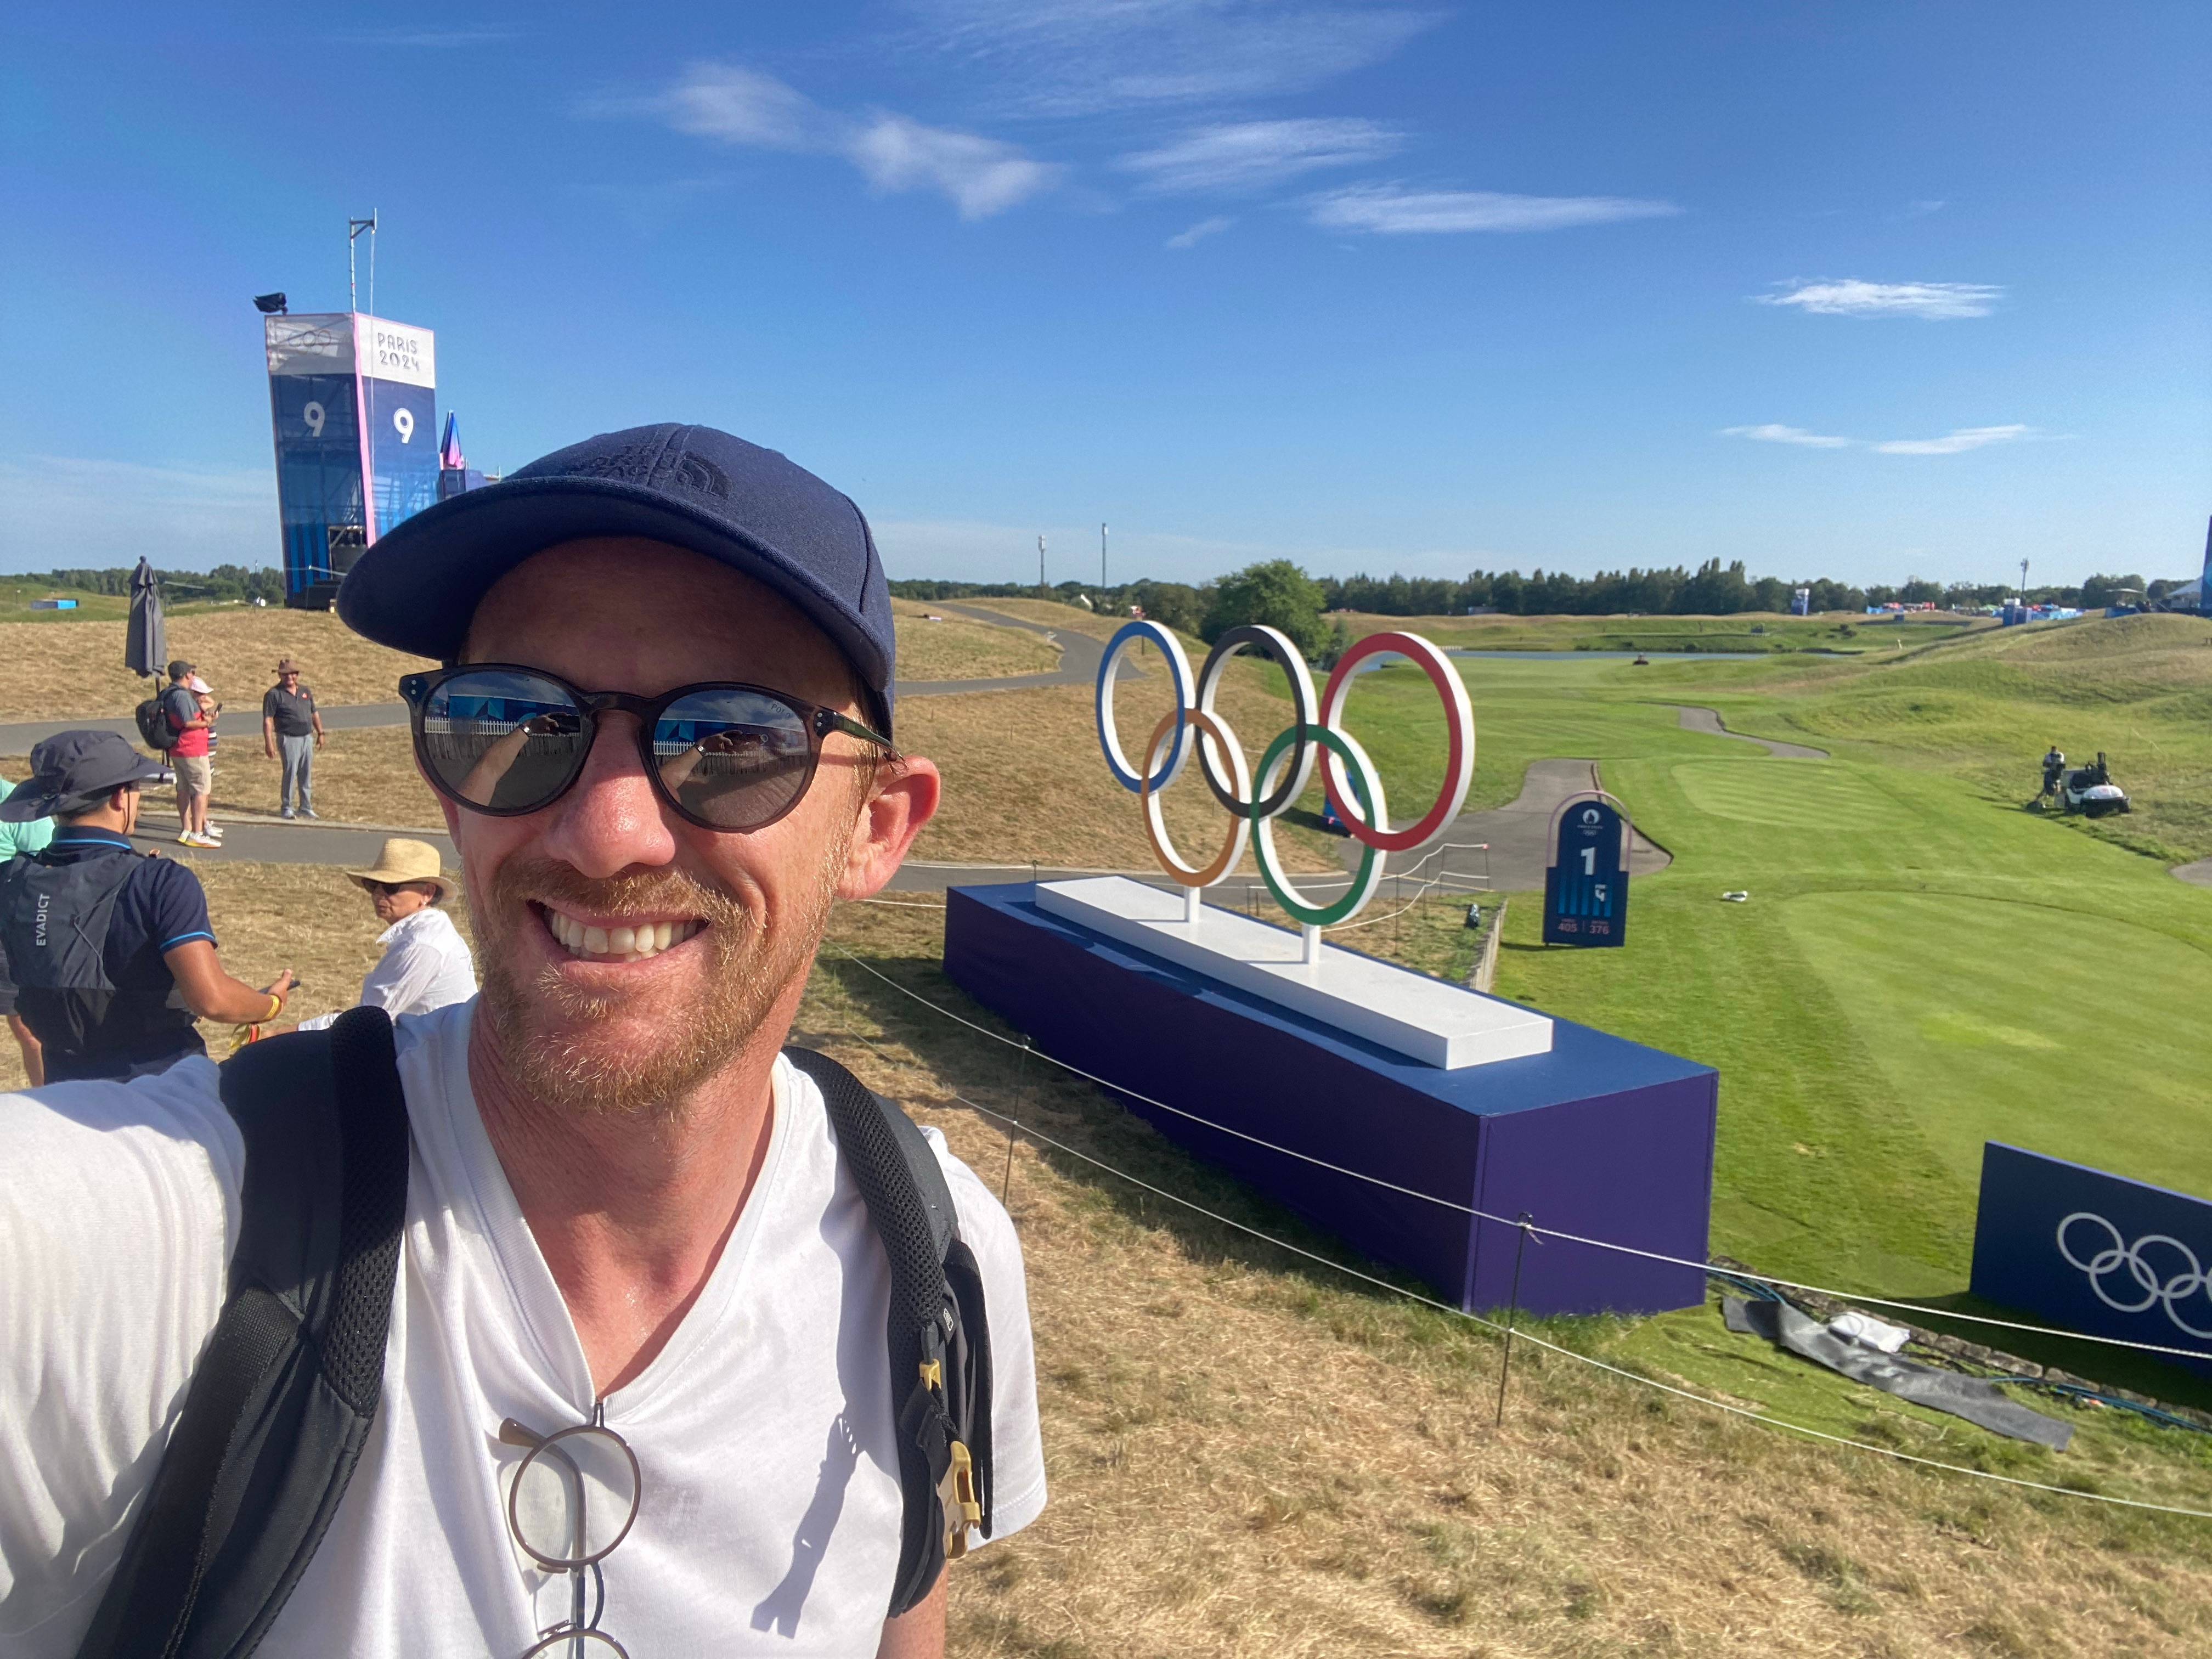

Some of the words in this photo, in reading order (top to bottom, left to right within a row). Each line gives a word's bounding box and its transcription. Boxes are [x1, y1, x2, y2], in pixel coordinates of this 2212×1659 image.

[377, 332, 417, 354] PARIS
[379, 349, 420, 371] 2024
[303, 401, 325, 437] 9
[393, 408, 414, 444] 9
[771, 703, 791, 719] POLO
[1581, 847, 1595, 876] 1
[35, 893, 50, 946] EVADICT
